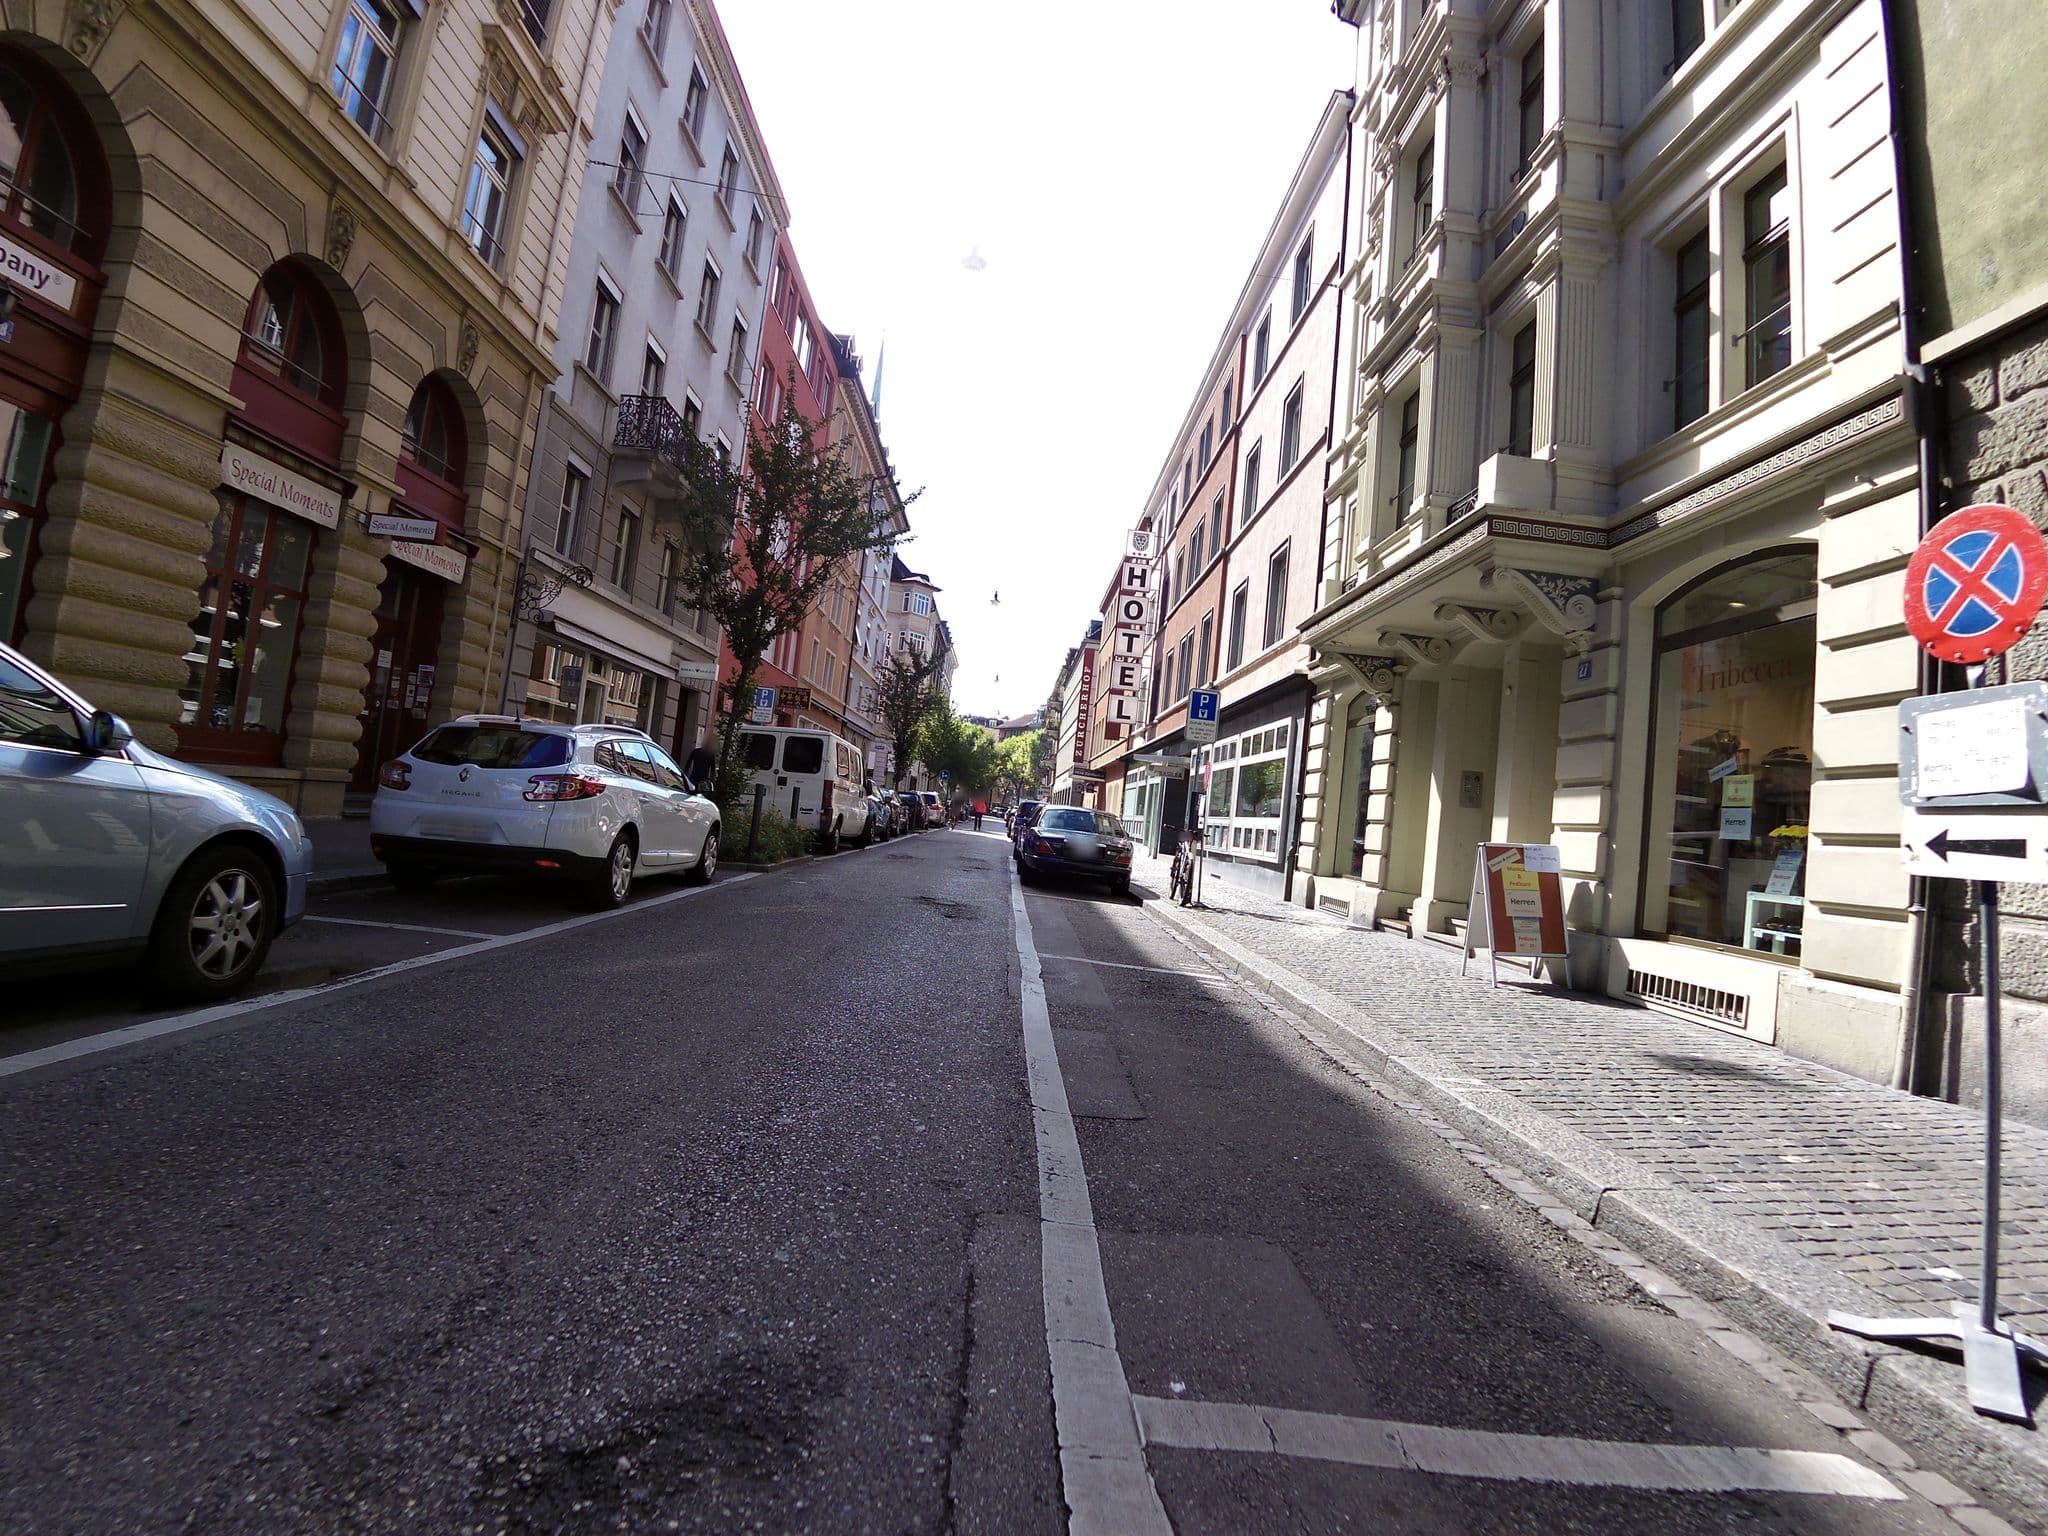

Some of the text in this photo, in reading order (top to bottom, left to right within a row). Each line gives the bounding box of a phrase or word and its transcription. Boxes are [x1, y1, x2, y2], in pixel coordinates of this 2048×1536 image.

[231, 458, 335, 519] Special Moments
[371, 519, 435, 535] Special Moments
[394, 540, 461, 577] Special Moments
[1115, 566, 1148, 720] HOTEL
[1199, 694, 1210, 707] P
[1510, 897, 1536, 906] Herren
